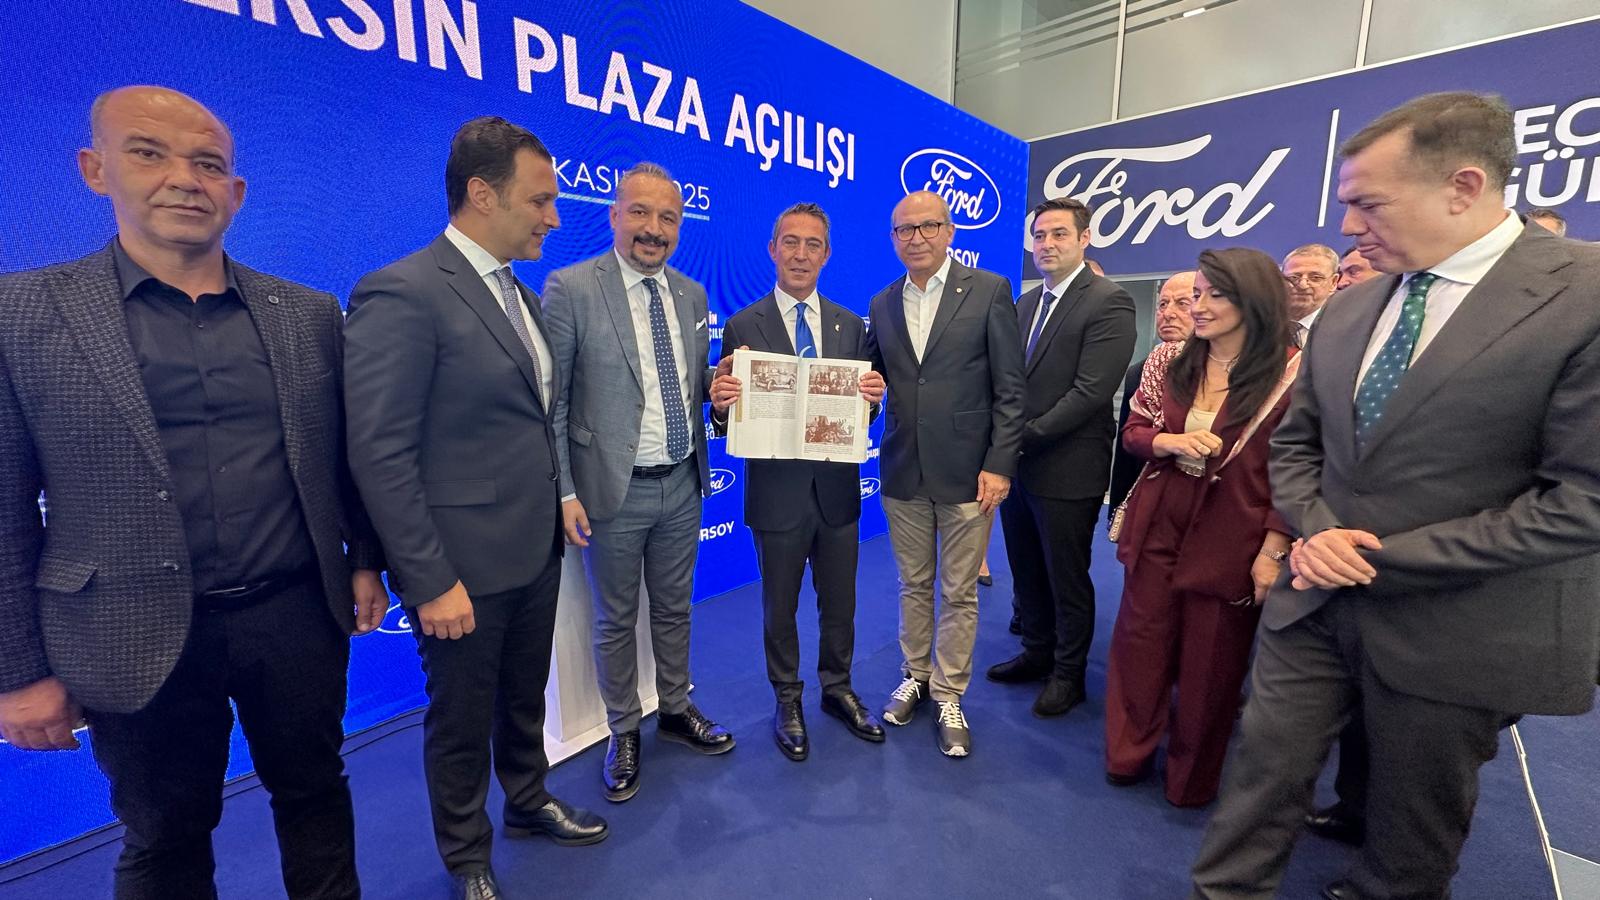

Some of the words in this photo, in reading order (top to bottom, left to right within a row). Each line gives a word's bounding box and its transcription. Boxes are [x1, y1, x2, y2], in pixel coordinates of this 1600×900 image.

[513, 17, 711, 142] PLAZA
[724, 94, 855, 189] AÇILIŞI
[552, 156, 627, 193] KASI
[923, 158, 985, 221] Ford
[1023, 134, 1291, 252] Ford
